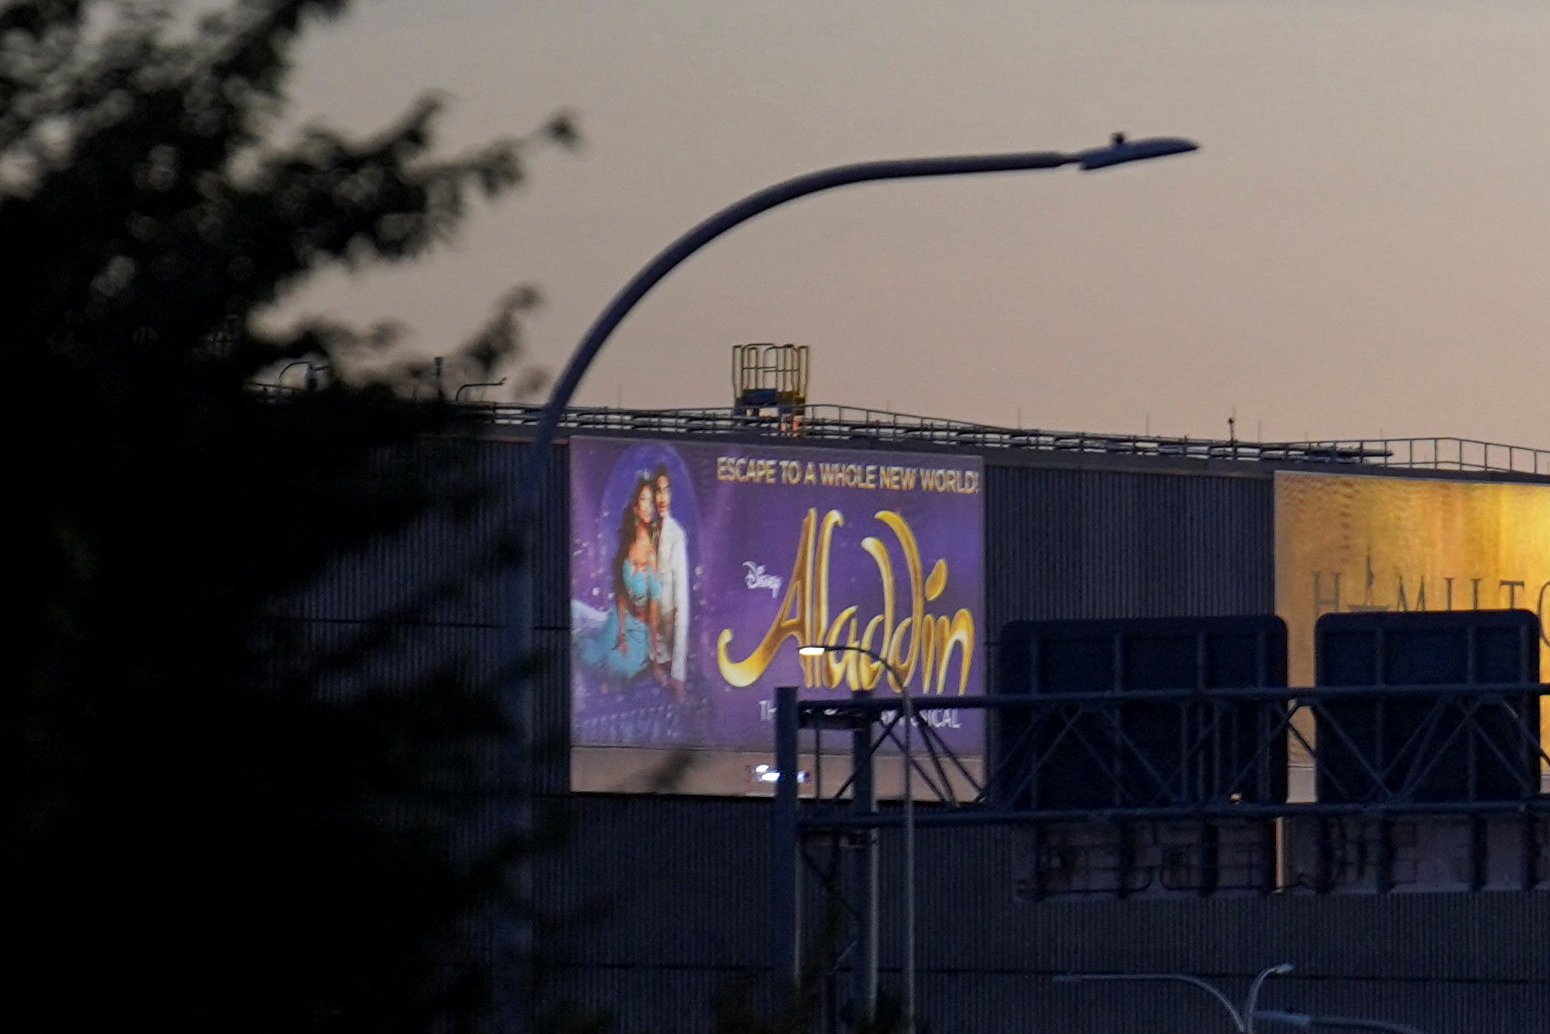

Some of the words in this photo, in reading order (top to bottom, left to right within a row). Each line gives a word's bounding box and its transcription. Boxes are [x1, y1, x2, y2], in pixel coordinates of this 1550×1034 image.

[717, 456, 776, 484] ESCAPE
[779, 460, 800, 485] TO
[803, 461, 817, 486] A
[819, 462, 875, 489] WHOLE
[879, 466, 917, 491] NEW
[919, 468, 979, 494] WORLD!
[742, 561, 783, 598] Disney
[717, 508, 976, 695] Aladdin
